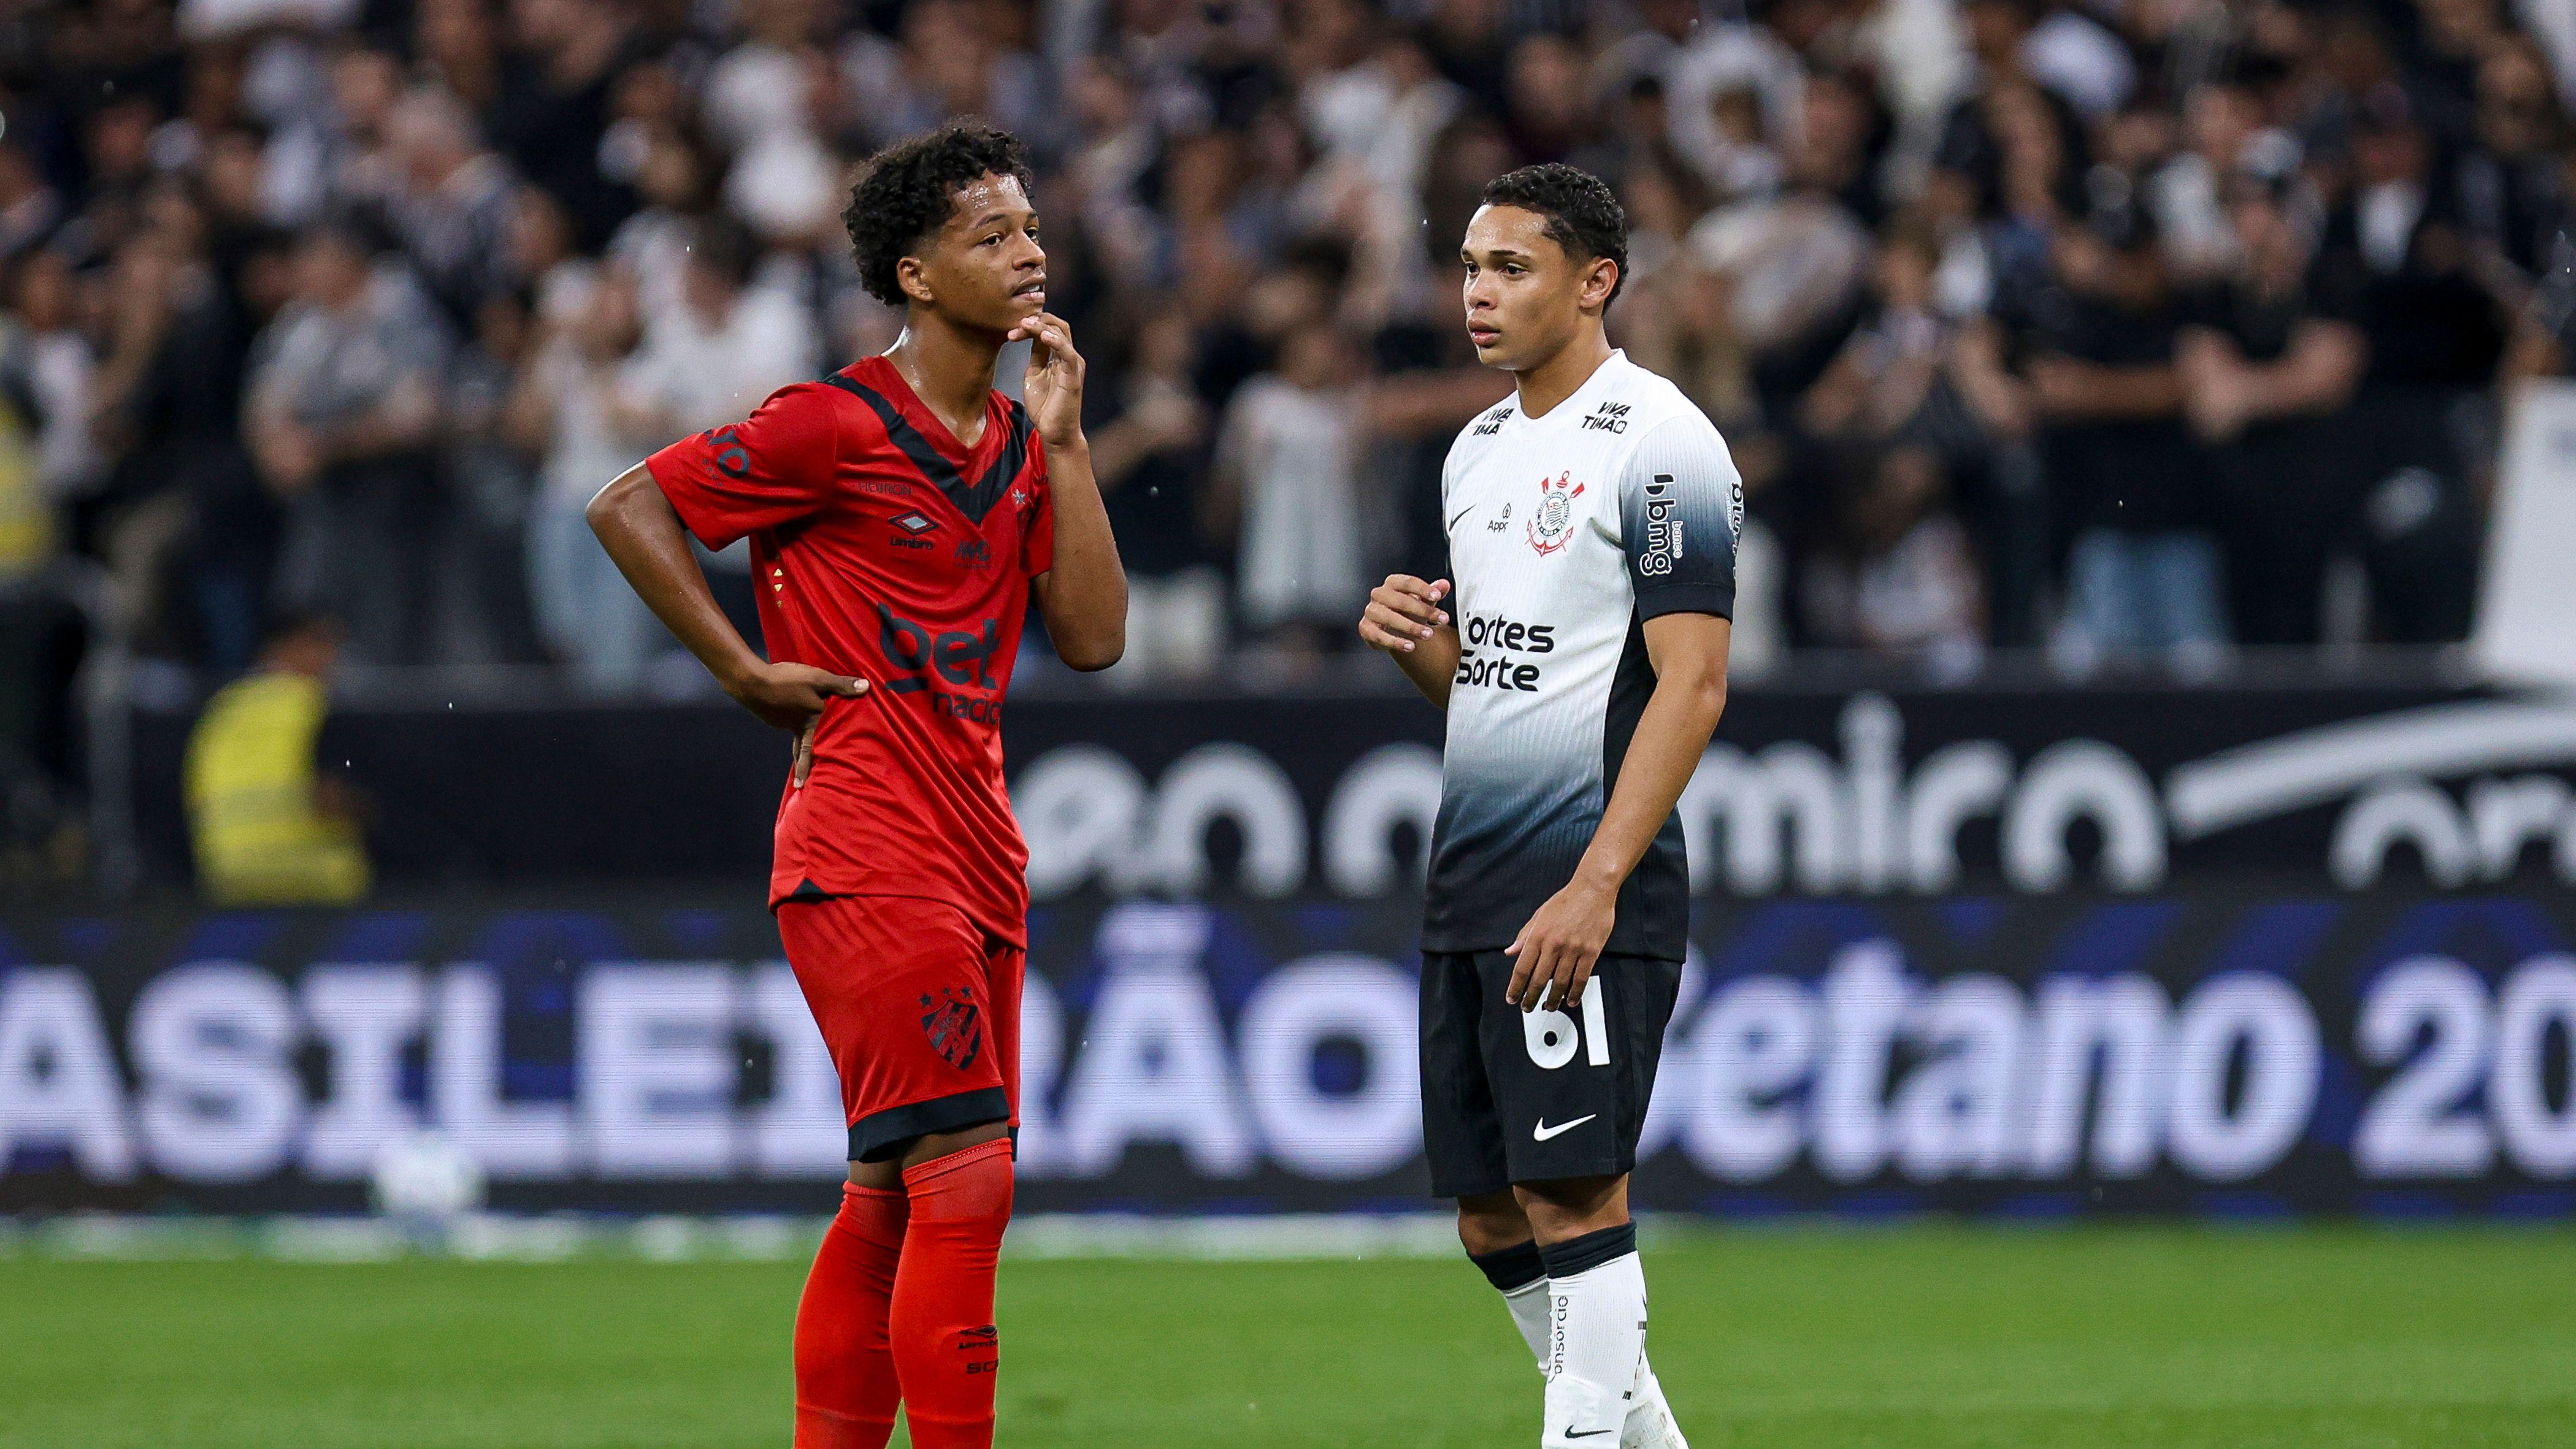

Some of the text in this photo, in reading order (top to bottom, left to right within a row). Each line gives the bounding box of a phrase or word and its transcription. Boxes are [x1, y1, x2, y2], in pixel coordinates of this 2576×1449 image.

[1598, 402, 1631, 417] VIVA
[1639, 499, 1676, 575] bmg
[1671, 521, 1684, 559] banco
[878, 602, 1001, 690] bet
[1522, 975, 1611, 1069] 61
